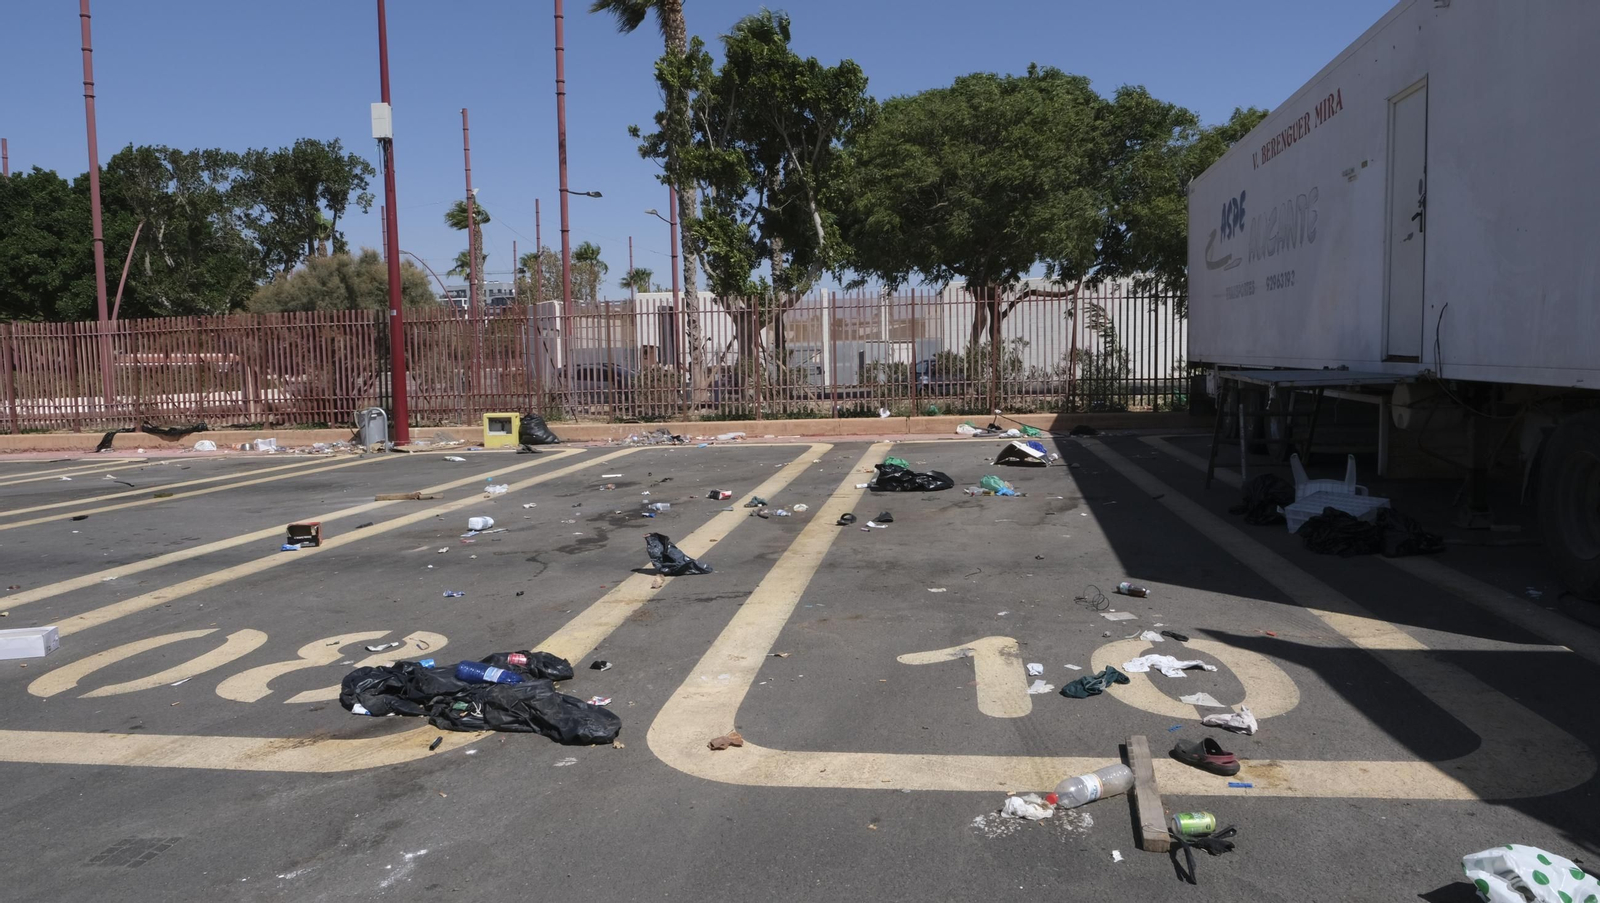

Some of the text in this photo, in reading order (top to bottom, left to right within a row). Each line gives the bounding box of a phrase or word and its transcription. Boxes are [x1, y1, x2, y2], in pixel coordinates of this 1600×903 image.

[1252, 87, 1343, 170] V. BERENGUER MIRA
[1220, 189, 1246, 244] ASPE
[896, 636, 1300, 720] 10
